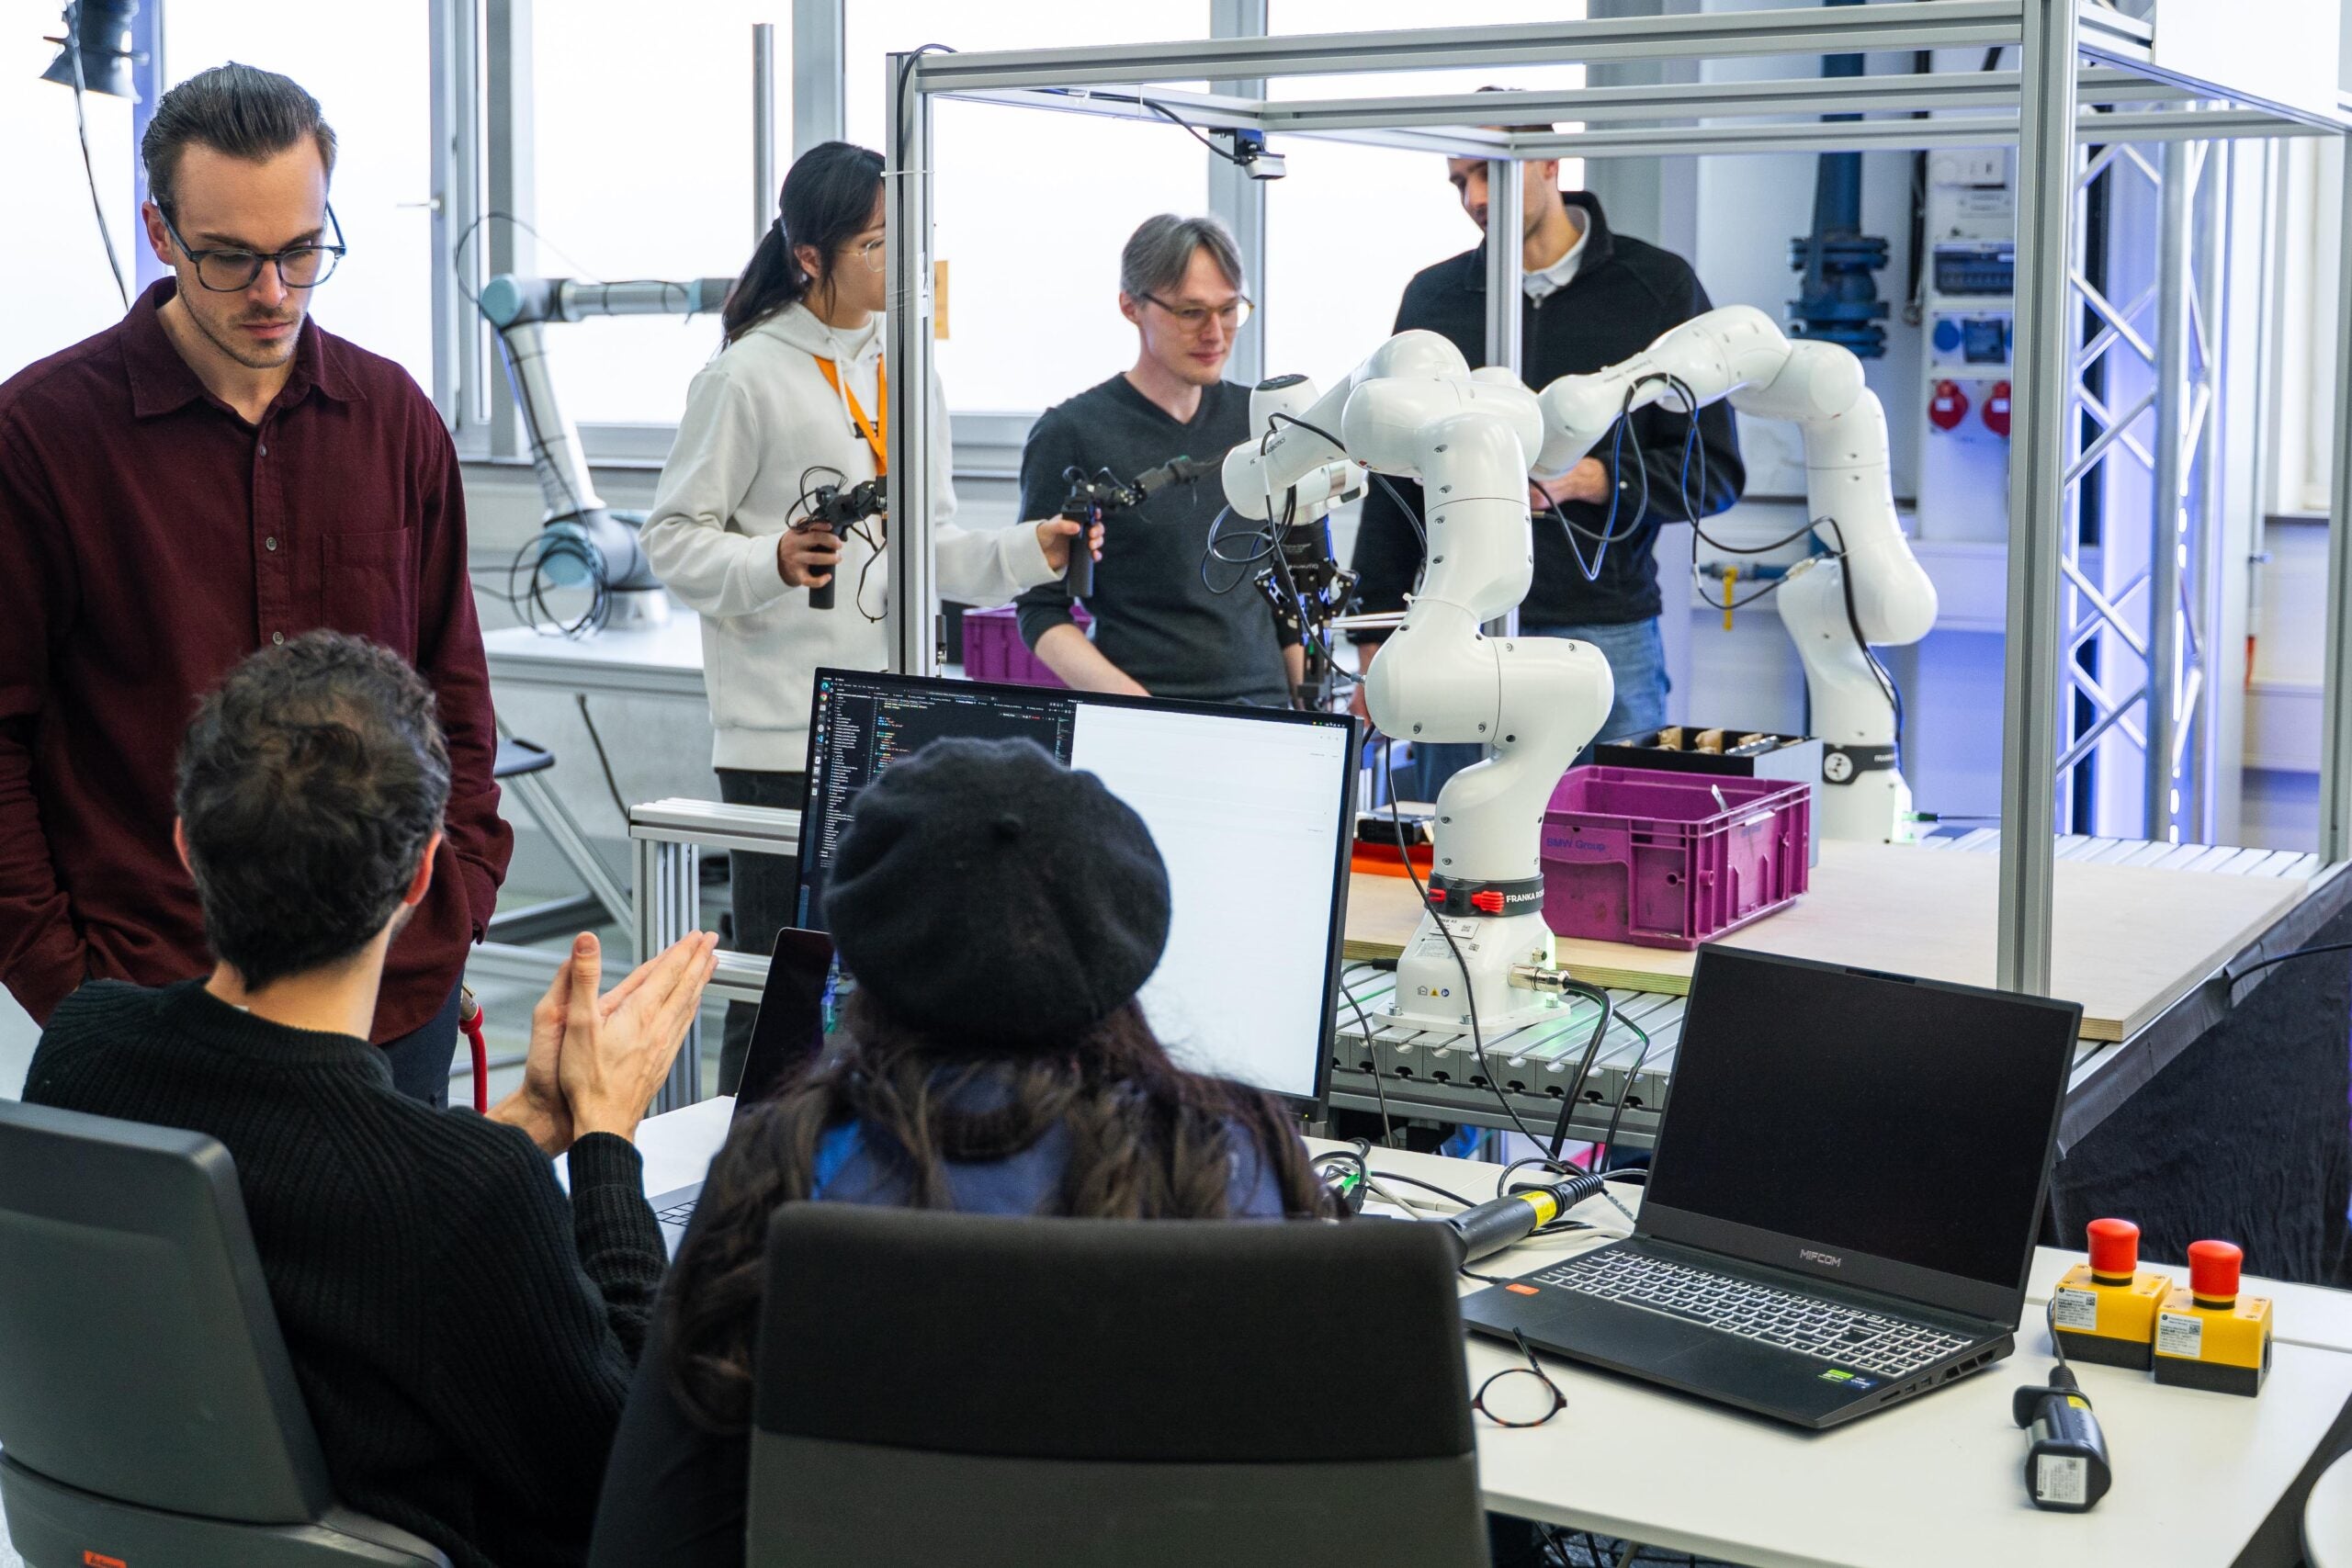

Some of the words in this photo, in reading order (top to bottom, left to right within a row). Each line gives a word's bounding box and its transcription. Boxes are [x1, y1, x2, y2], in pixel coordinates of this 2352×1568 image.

[1546, 837, 1573, 848] BMW
[1575, 839, 1606, 852] Group
[1506, 892, 1535, 903] FRANKA
[1799, 1248, 1841, 1268] MIFCOM
